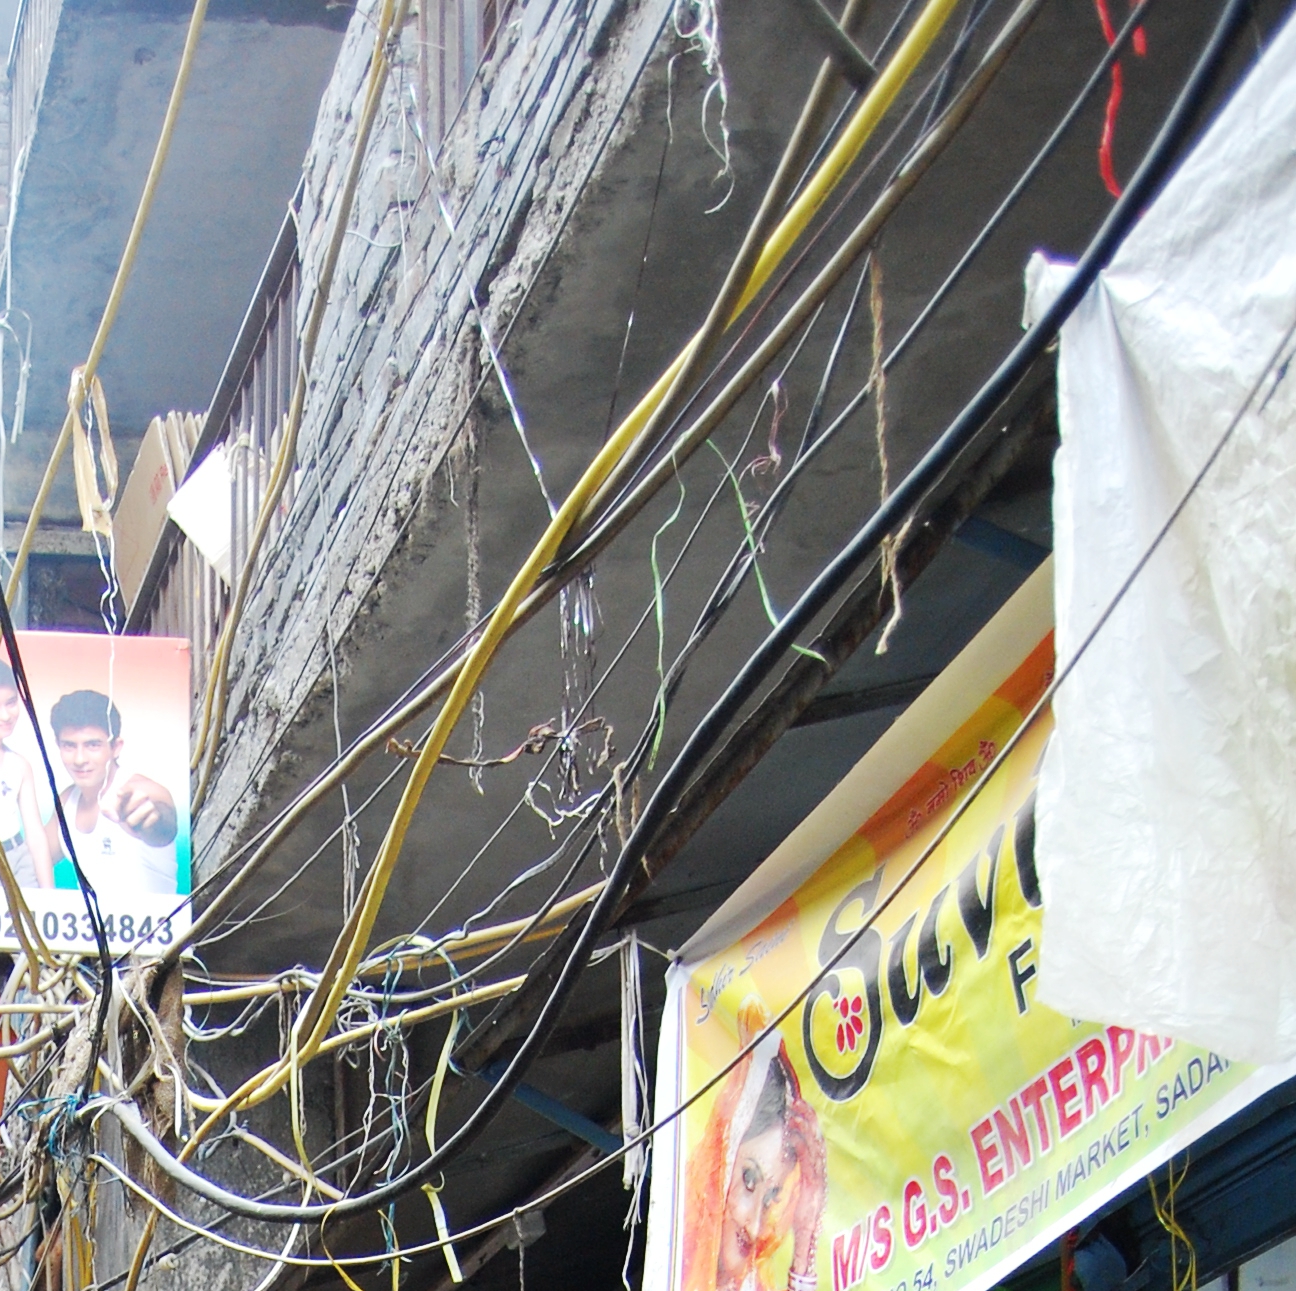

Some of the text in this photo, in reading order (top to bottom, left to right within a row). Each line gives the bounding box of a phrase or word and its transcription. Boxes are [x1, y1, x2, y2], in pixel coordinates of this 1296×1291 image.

[903, 1155, 971, 1248] G.S.
[944, 1187, 1049, 1278] SWADESHI
[1055, 1104, 1150, 1200] MARKET,
